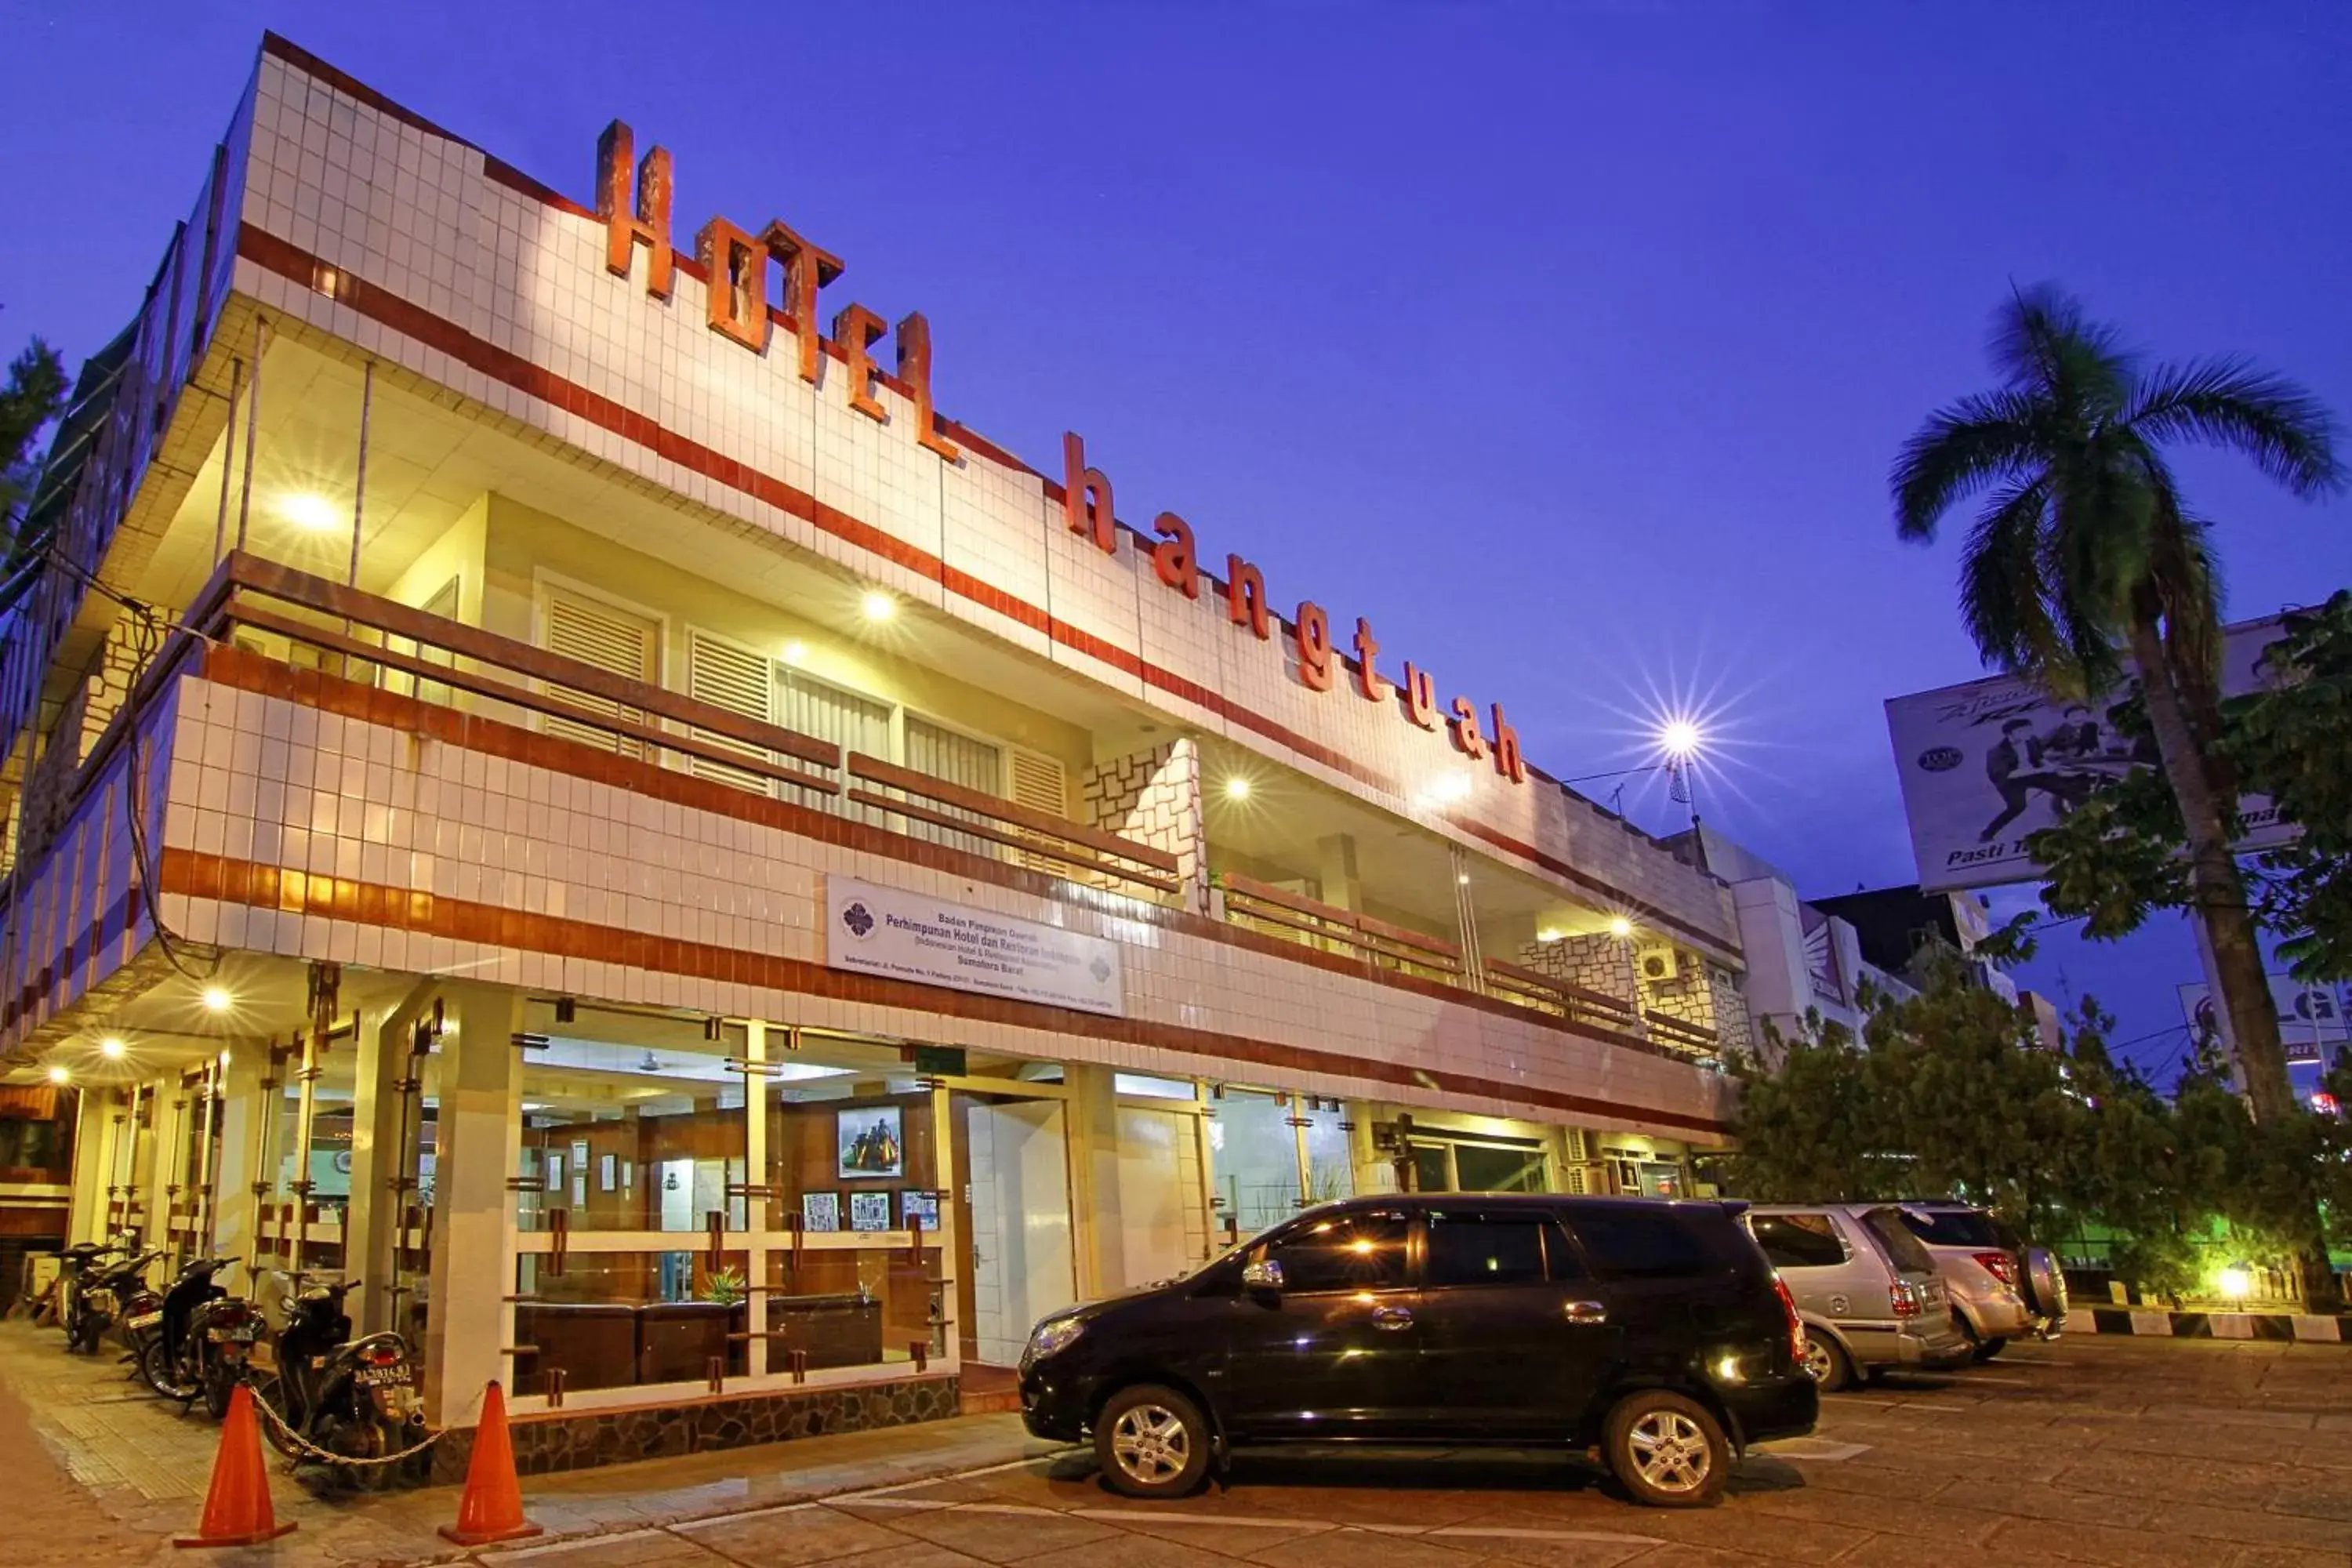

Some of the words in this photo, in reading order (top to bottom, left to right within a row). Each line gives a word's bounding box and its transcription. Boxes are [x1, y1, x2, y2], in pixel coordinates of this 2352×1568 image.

[596, 118, 959, 464] HOTEL
[1947, 843, 2006, 866] Pasti
[886, 913, 951, 939] Perhimpunan
[953, 928, 979, 945] Hotel
[981, 935, 998, 948] dan
